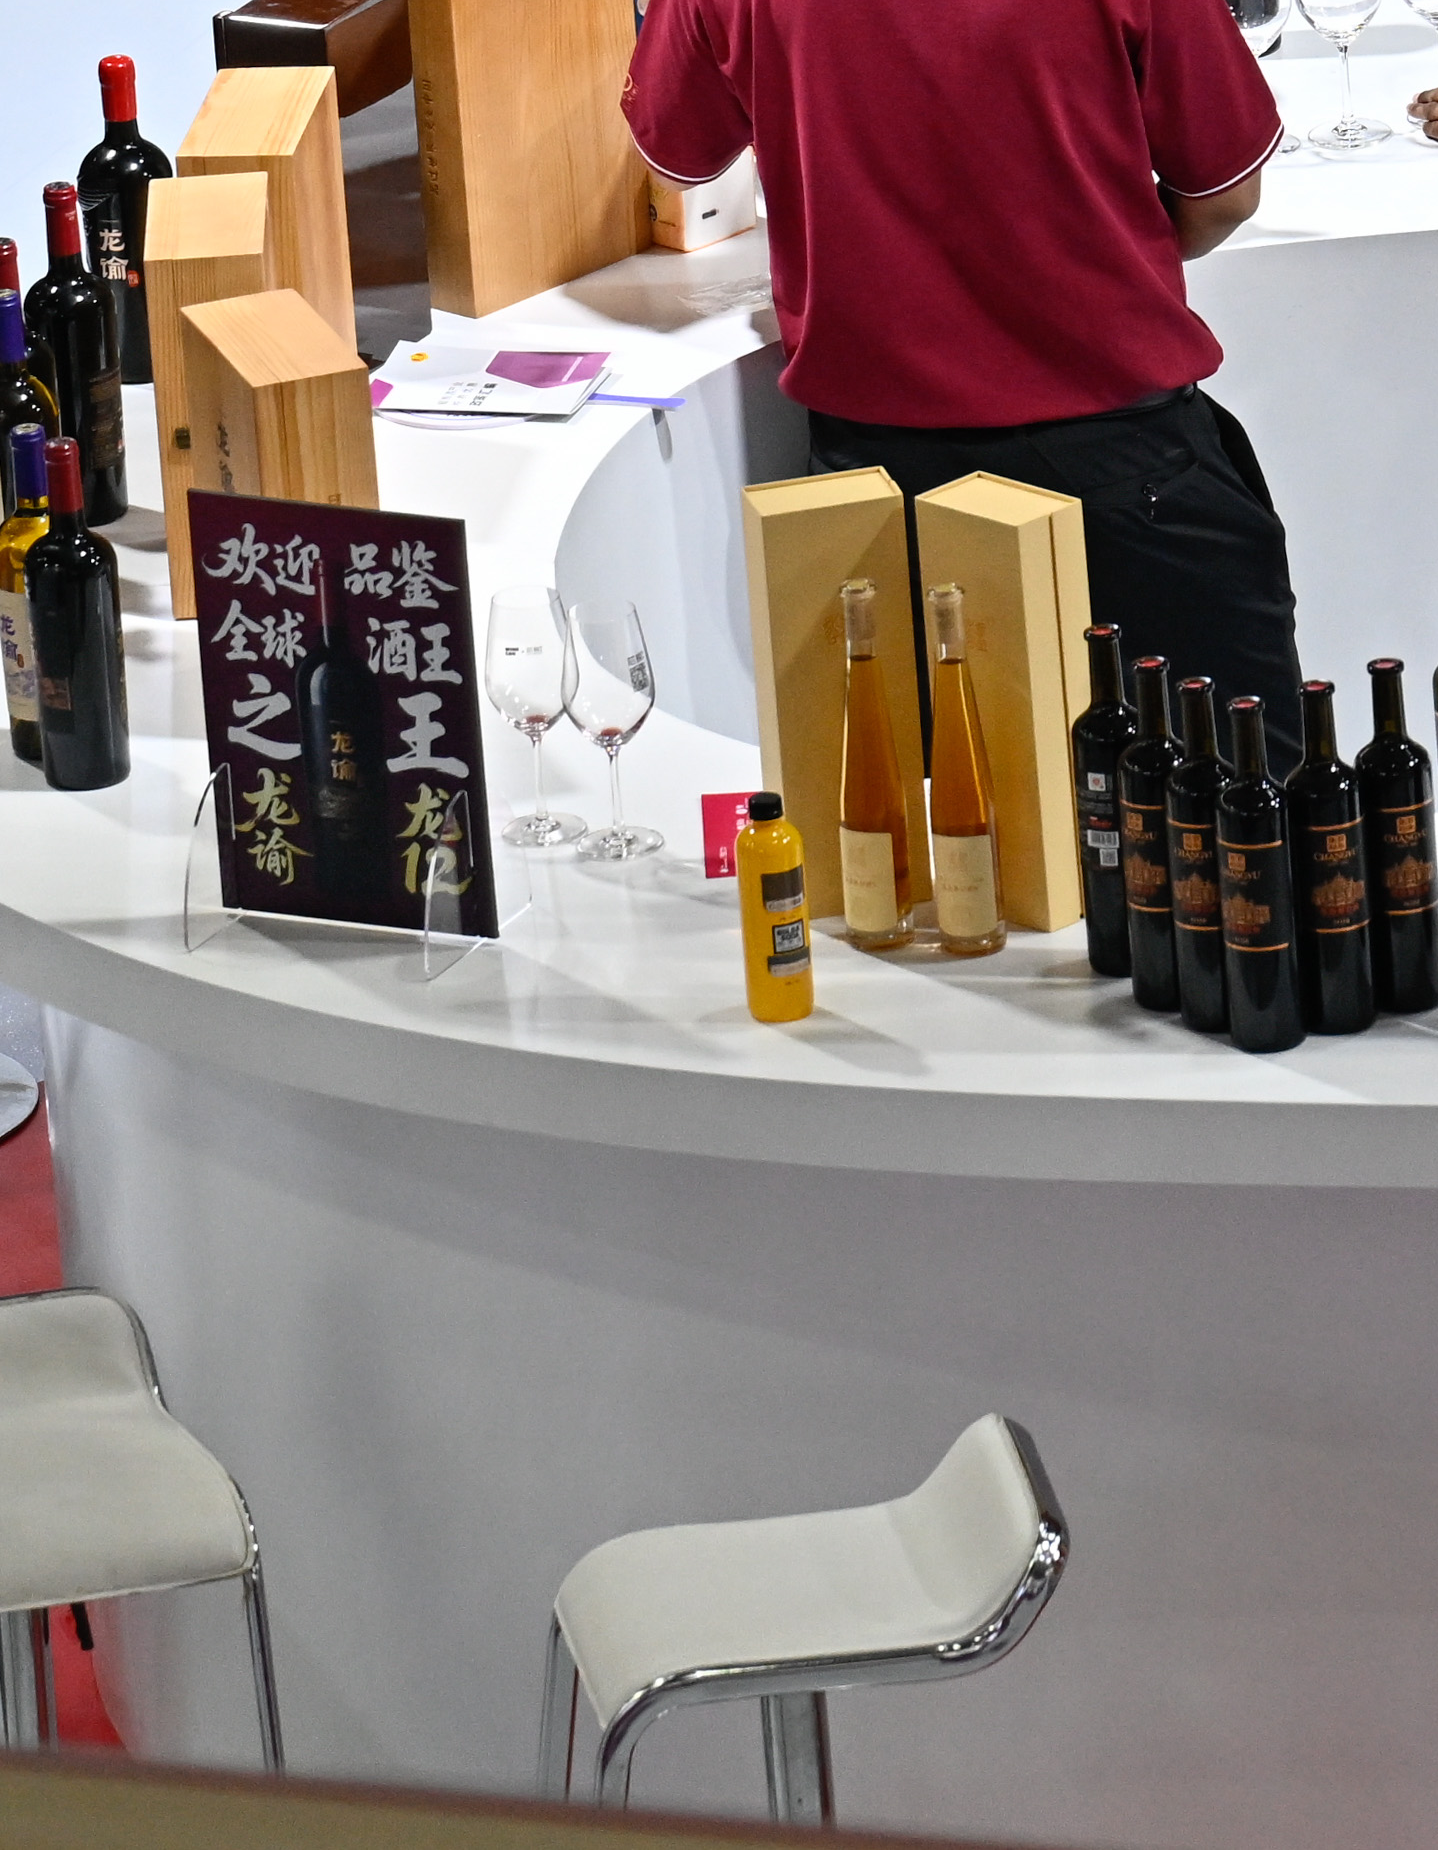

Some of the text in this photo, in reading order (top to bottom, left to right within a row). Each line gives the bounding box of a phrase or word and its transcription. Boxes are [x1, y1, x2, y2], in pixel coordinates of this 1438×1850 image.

[99, 229, 129, 281] 龙谕
[203, 522, 460, 610] 欢迎 品鉴
[211, 599, 463, 685] 全球 酒王
[227, 674, 471, 780] 之 王
